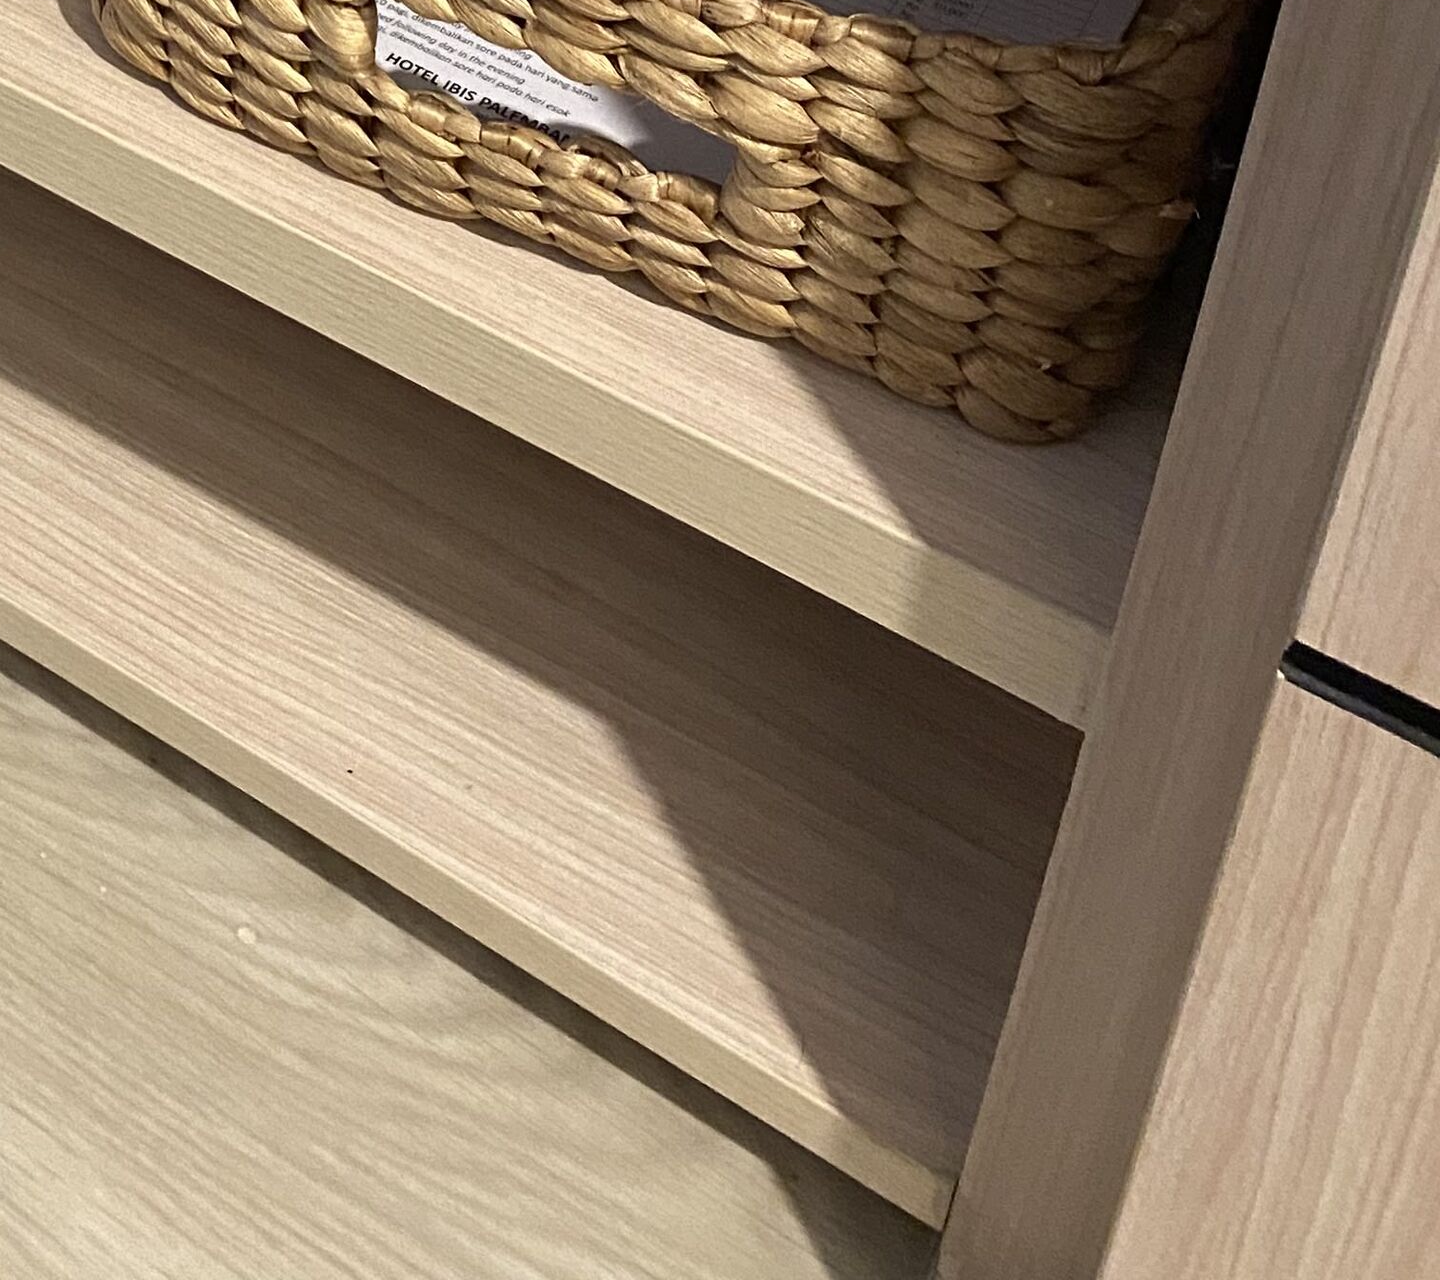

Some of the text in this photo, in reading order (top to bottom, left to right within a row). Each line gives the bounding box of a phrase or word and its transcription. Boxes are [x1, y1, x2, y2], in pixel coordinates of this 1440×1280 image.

[385, 52, 438, 86] HOTEL
[443, 79, 478, 102] IBIS
[389, 31, 570, 117] dikembalikan sore hari pada hari esok
[392, 20, 438, 45] following
[438, 42, 458, 54] day
[460, 50, 468, 60] in
[469, 54, 486, 68] the
[487, 62, 525, 86] evening
[475, 43, 498, 58] sore
[498, 52, 523, 70] pada
[524, 64, 546, 79] hari
[546, 74, 570, 92] yang
[571, 86, 598, 102] sama
